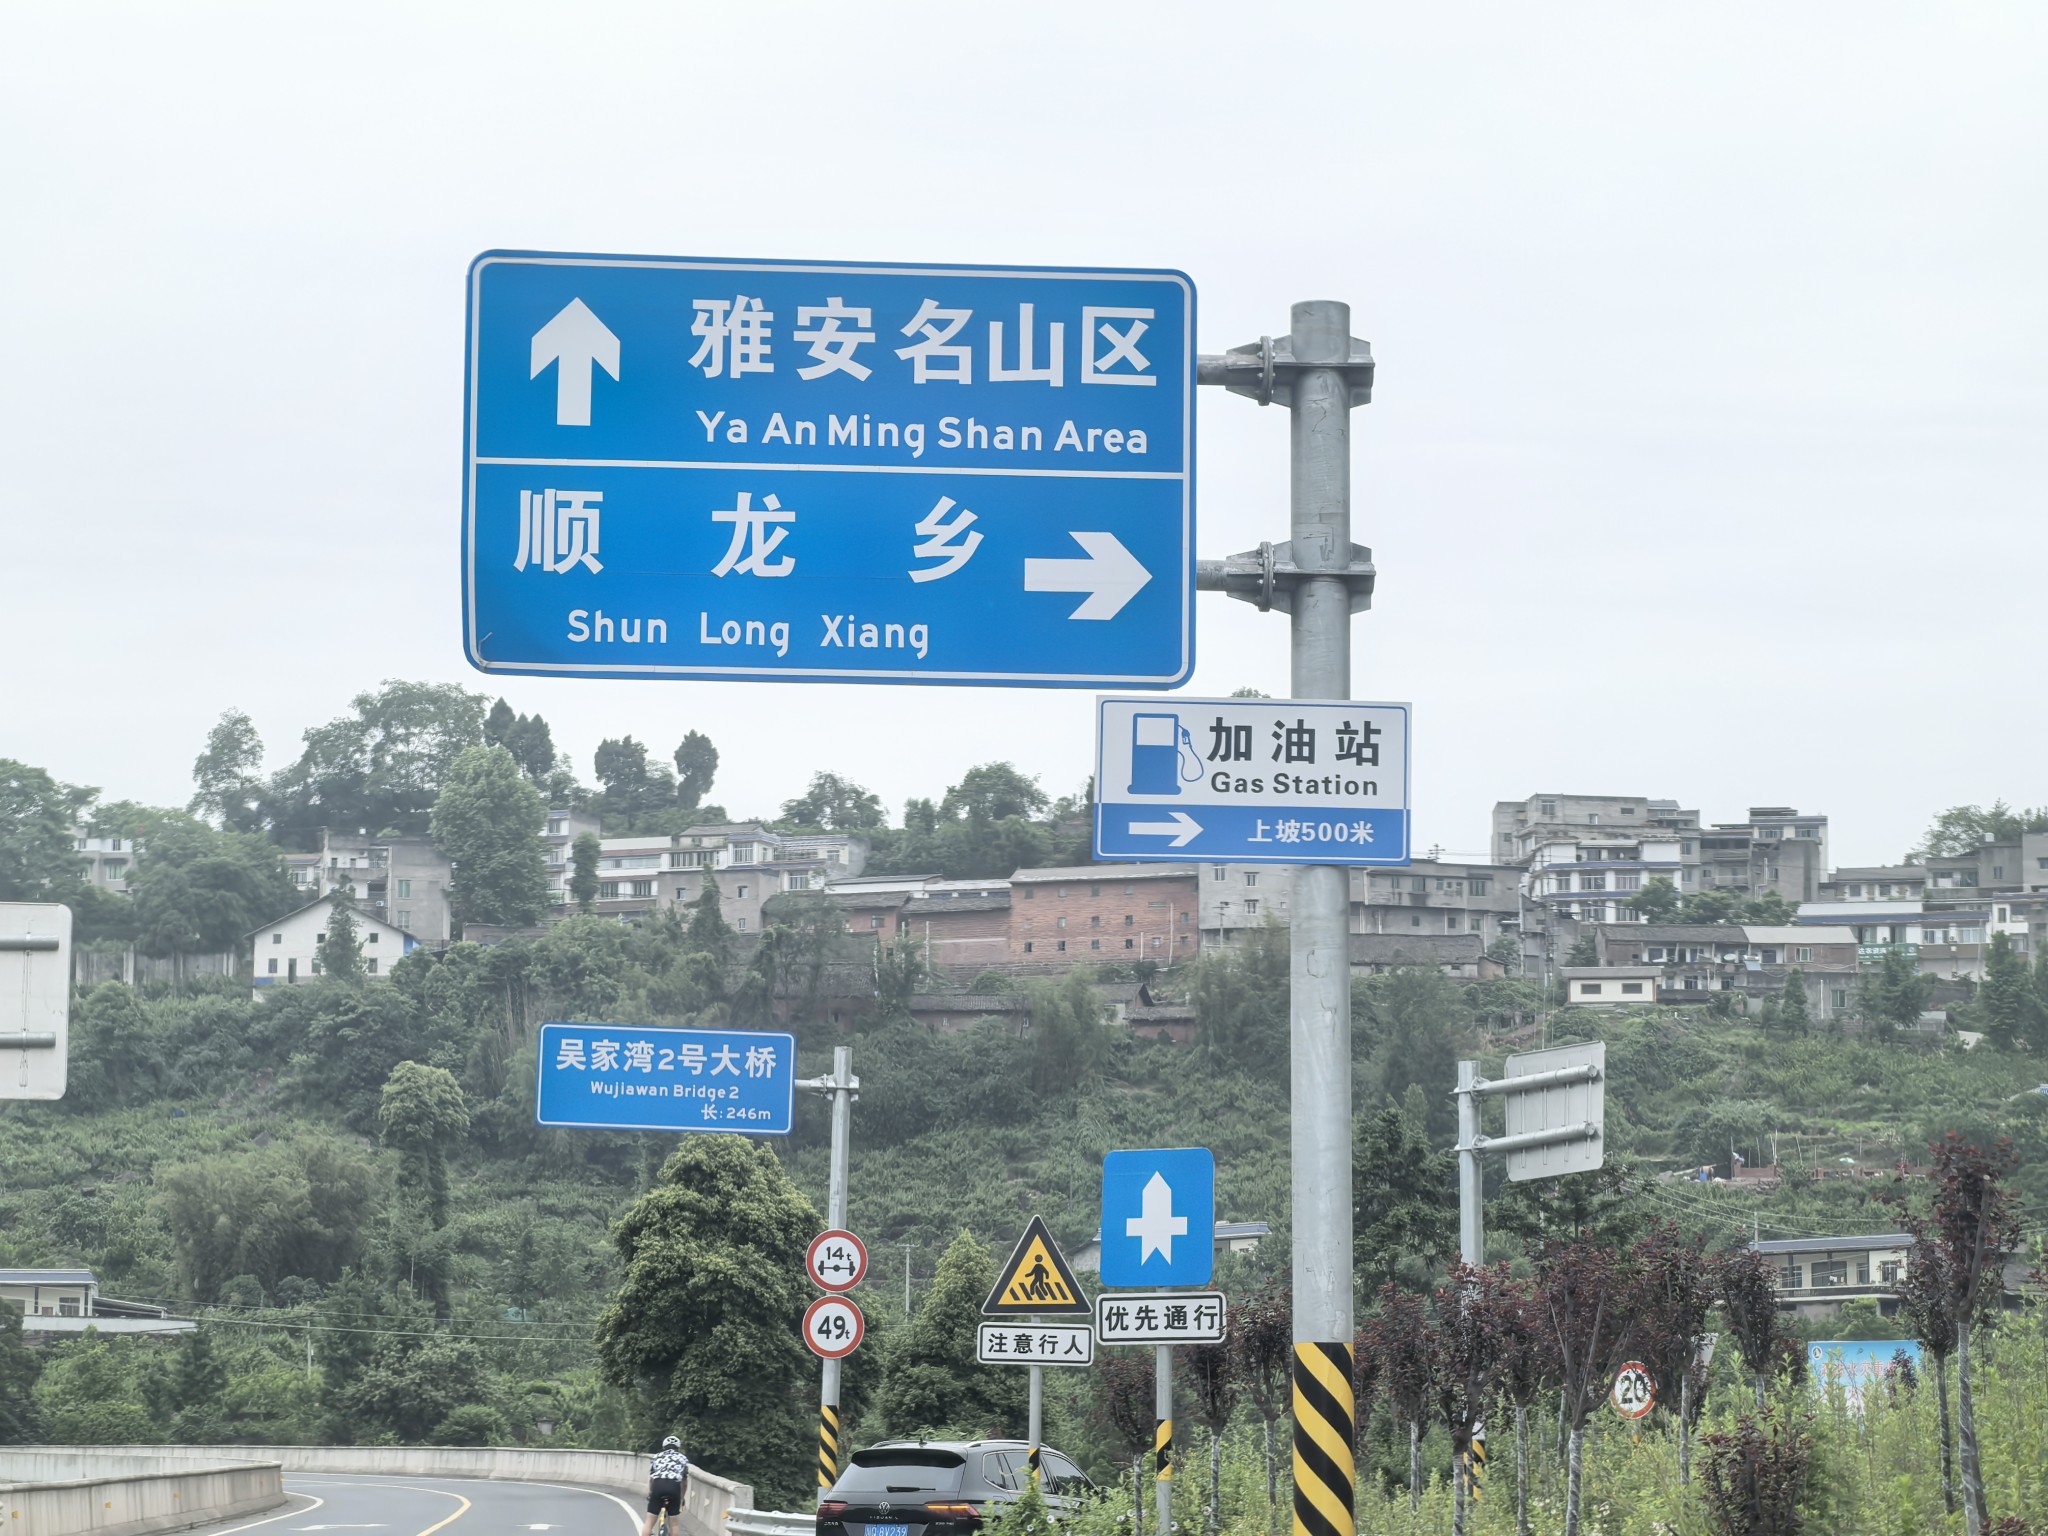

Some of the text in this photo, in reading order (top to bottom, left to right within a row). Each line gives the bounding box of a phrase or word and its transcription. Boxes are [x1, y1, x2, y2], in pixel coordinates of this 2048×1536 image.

[687, 294, 1157, 388] 雅安名山区
[695, 410, 1148, 459] Ya An Ming Shan Area
[567, 609, 929, 660] Shun Long Xiang
[1206, 716, 1382, 767] 加油站
[1210, 771, 1378, 796] Gas Station
[1247, 819, 1375, 845] 上坡500米
[556, 1038, 777, 1079] 吴家湾2号大桥
[590, 1080, 669, 1099] Wujiawan
[1104, 1304, 1218, 1332] 优先通行
[987, 1332, 1084, 1356] 注意行人
